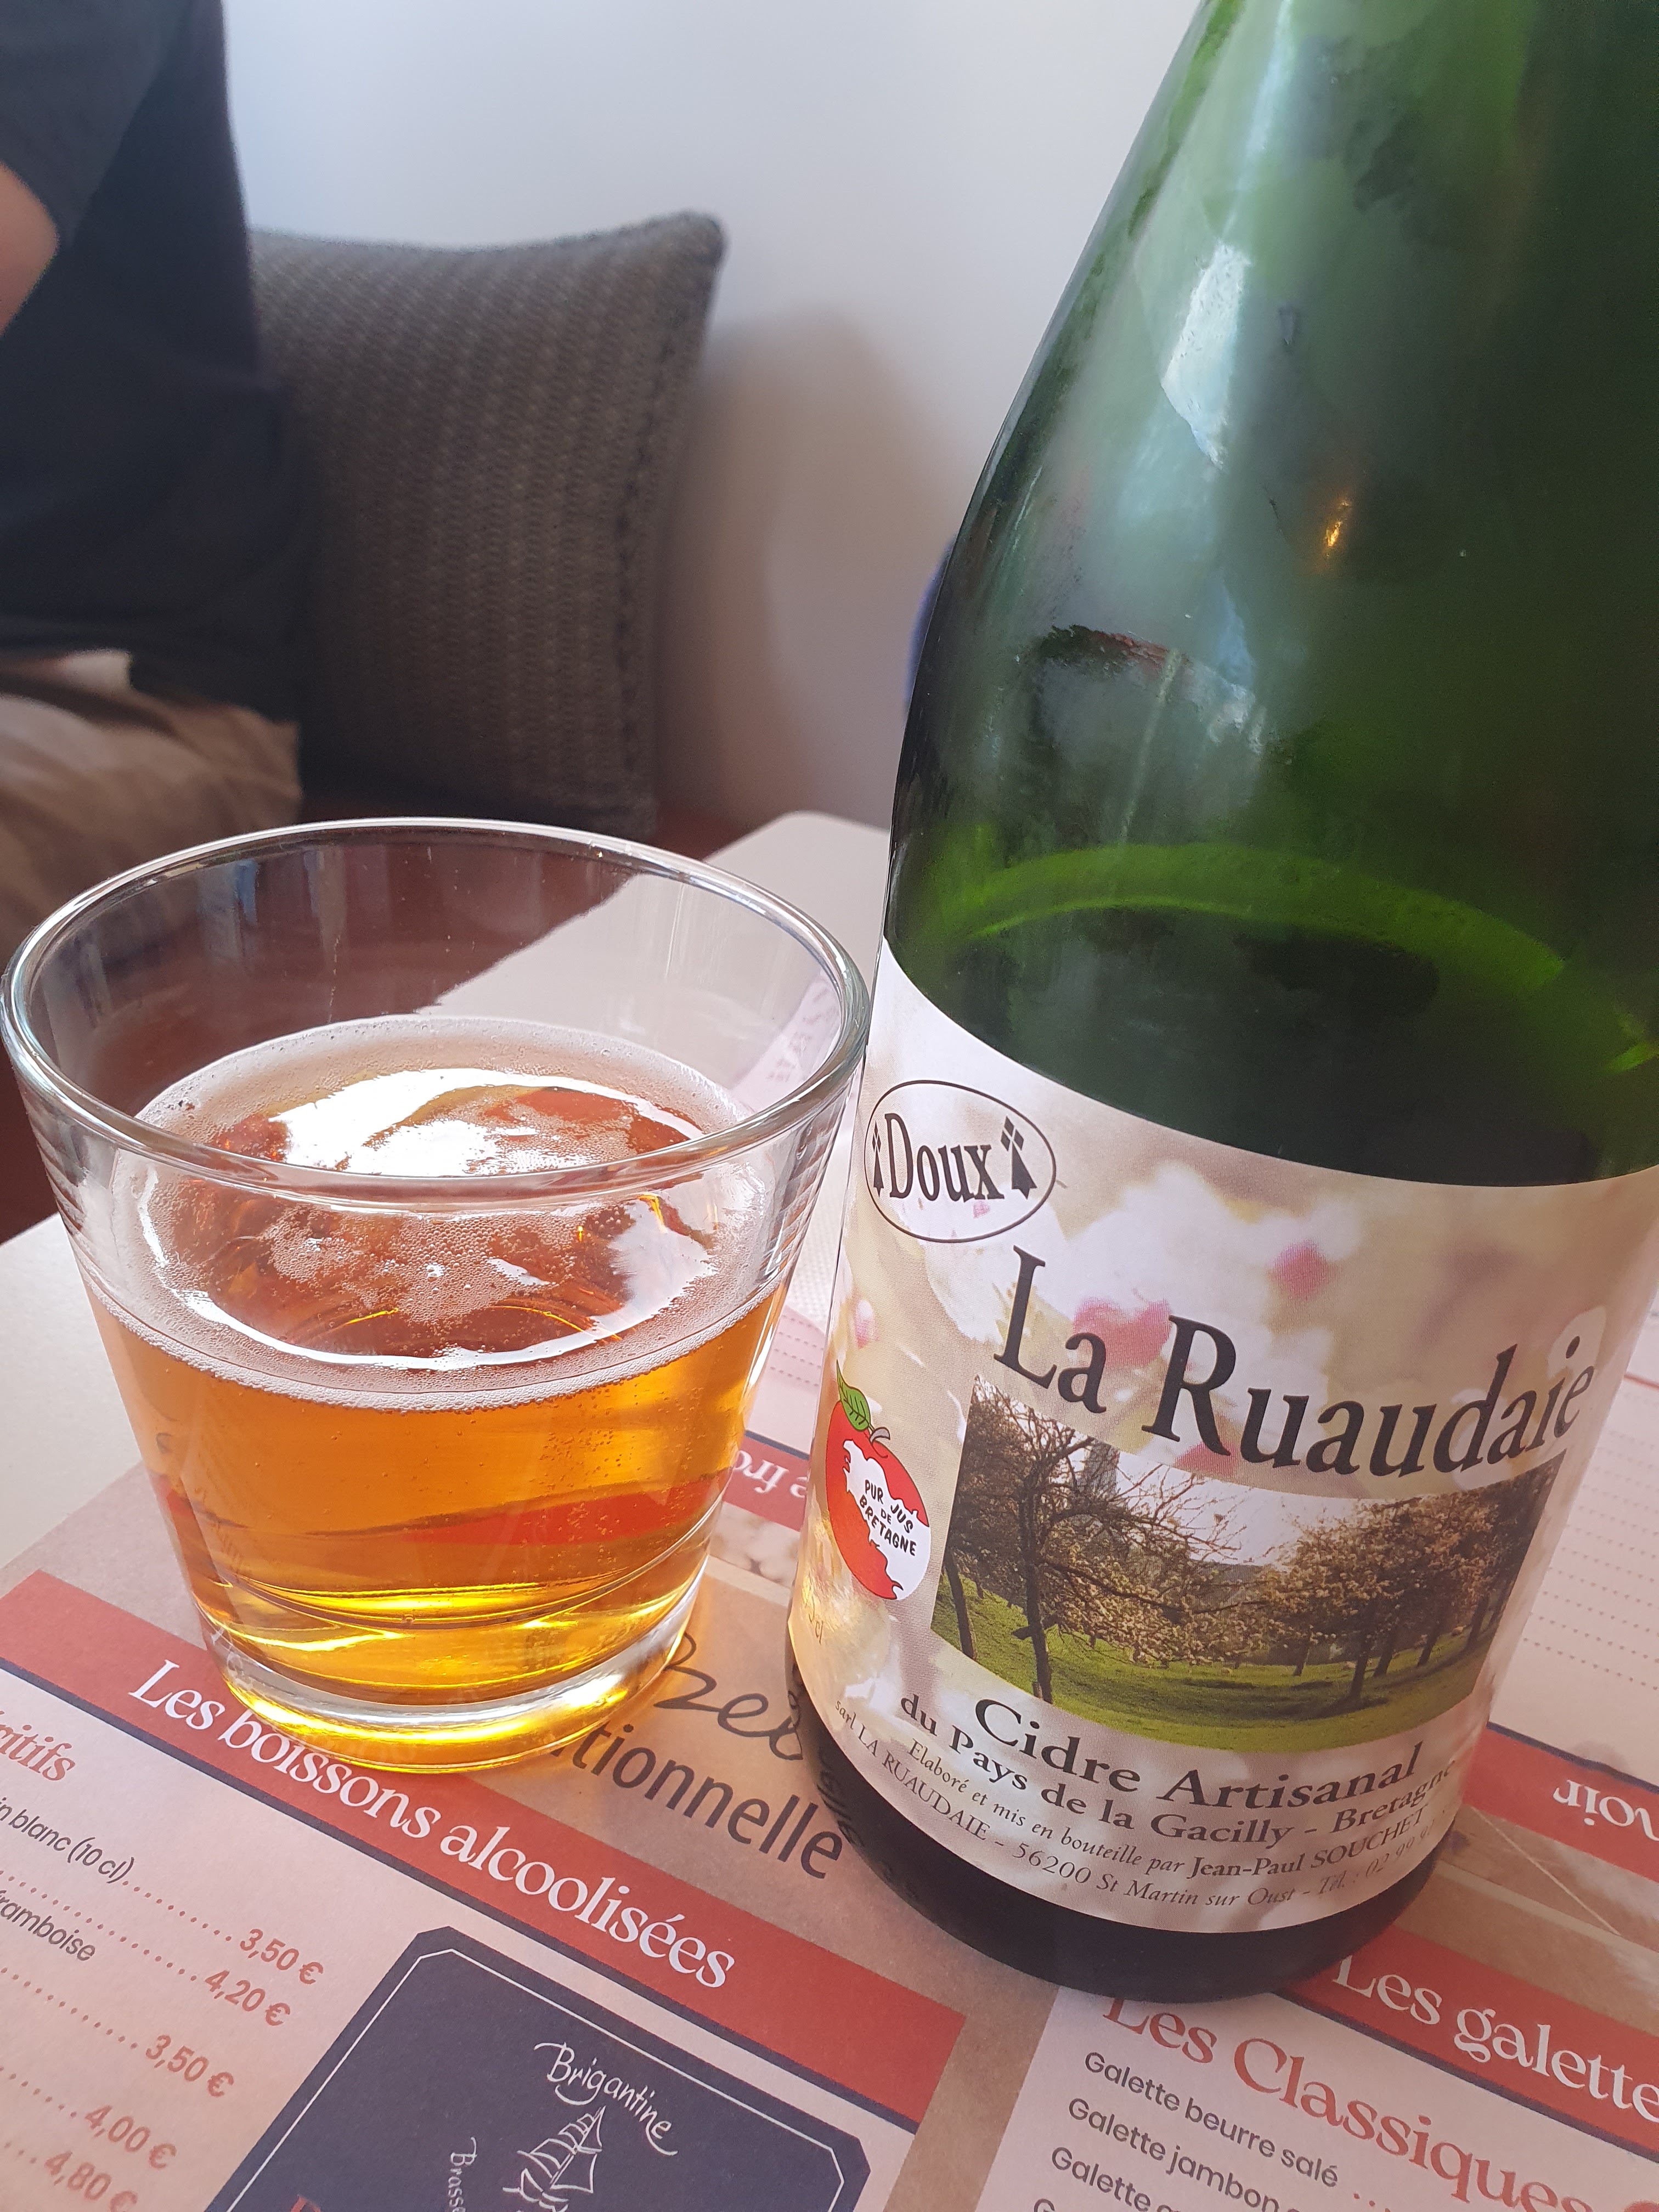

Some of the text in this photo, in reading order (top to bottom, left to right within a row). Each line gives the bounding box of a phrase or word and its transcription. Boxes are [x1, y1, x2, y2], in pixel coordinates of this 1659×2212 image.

[884, 1113, 1005, 1203] Doux
[994, 1245, 1594, 1477] La Ruaudaie
[860, 1494, 916, 1557] BRETAGNE
[865, 1480, 913, 1533] PUR JUS
[881, 1508, 892, 1523] DE
[0, 1711, 76, 1781] ritifs
[901, 1694, 937, 1736] du
[949, 1725, 1028, 1791] Pays
[1041, 1783, 1087, 1815] de
[1098, 1799, 1135, 1830] la
[1150, 1813, 1291, 1848] Gacilly
[975, 1699, 1424, 1809] Cidre Artisanal
[128, 1659, 735, 1988] Les boissons alcoolisées
[551, 1720, 843, 1879] tionnelle
[836, 1700, 856, 1730] sarl
[856, 1724, 877, 1757] LA
[882, 1751, 991, 1841] RUAUDAIE
[1013, 1843, 1092, 1884] 56200
[1097, 1873, 1119, 1892] St
[1124, 1880, 1198, 1905] Martin
[1205, 1893, 1240, 1907] sur
[1248, 1887, 1296, 1905] Oust
[909, 1738, 970, 1793] Elaboré
[972, 1789, 988, 1806] et
[993, 1802, 1026, 1826] mis
[1032, 1822, 1053, 1839] en
[1061, 1827, 1143, 1866] bouteille
[1146, 1856, 1183, 1875] par
[1187, 1855, 1303, 1879] Jean-Paul
[1310, 1805, 1430, 1869] SOUCHET
[8, 1809, 71, 1852] blanc
[67, 1836, 103, 1866] (10
[98, 1857, 135, 1884] cl)
[240, 1928, 324, 1984] 3,50 €
[1332, 1955, 1442, 2025] Les
[204, 1970, 291, 2026] 4,20 €
[1103, 1997, 1217, 2063] Les
[145, 2035, 234, 2097] 3,50 €
[534, 2041, 678, 2156] Brigantine
[84, 2105, 177, 2169] 4,00 €
[1068, 2098, 1280, 2212] Galette jambon
[1085, 2052, 1338, 2188] Galette beurre salé
[44, 2150, 112, 2202] 4,80
[1051, 2147, 1151, 2212] Galette
